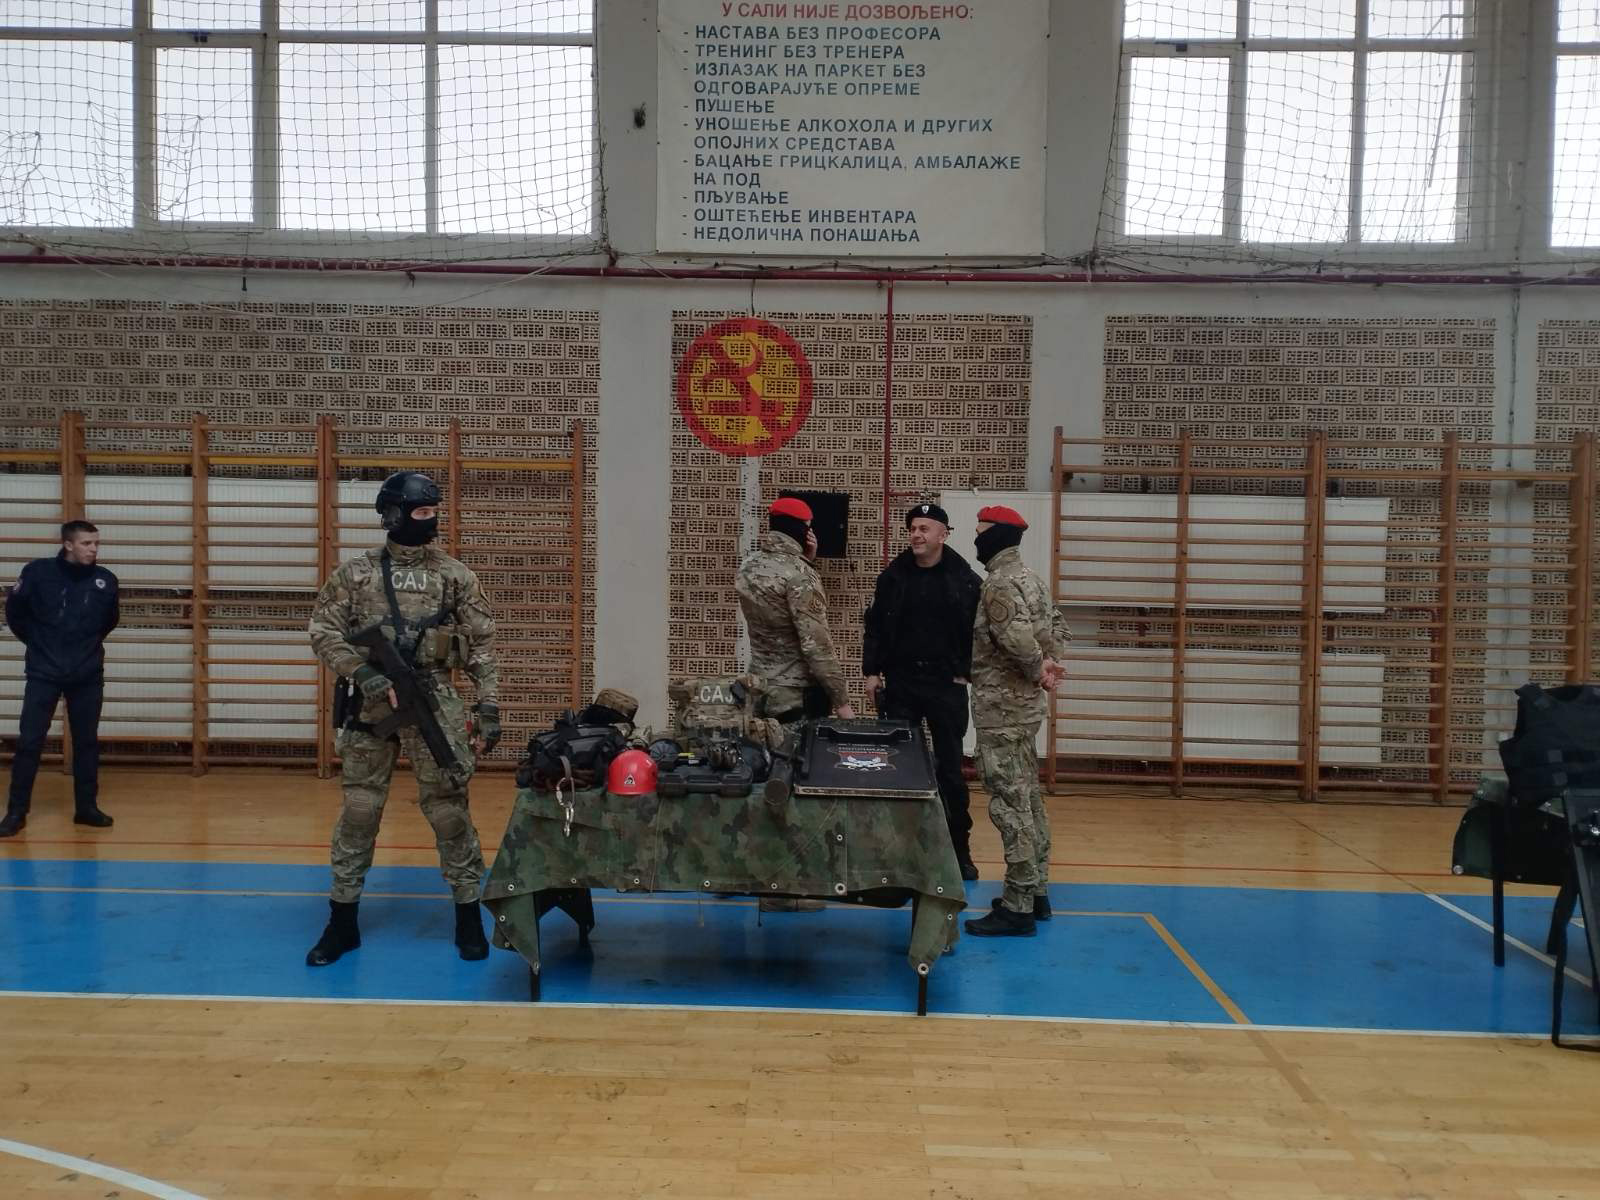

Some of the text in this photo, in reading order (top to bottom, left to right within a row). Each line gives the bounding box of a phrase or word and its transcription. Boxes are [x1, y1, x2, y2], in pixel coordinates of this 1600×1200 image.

[722, 2, 973, 21] У САЛИ НИЈЕ ДОЗВОЉЕНО:
[696, 25, 779, 40] НАСТАВА
[787, 27, 819, 40] БЕЗ
[827, 27, 940, 40] ПРОФЕСОРА
[695, 44, 777, 58] ТРЕНИНГ
[784, 45, 816, 58] БЕЗ
[823, 45, 904, 59] ТРЕНЕРА
[696, 62, 778, 77] ИЗЛАЗАК
[786, 64, 807, 77] НА
[816, 64, 886, 77] ПАРКЕТ
[893, 64, 925, 77] БЕЗ
[694, 80, 920, 96] ОДГОВАРАЈУЋЕ ОПРЕМЕ
[696, 98, 774, 113] ПУШЕЊЕ
[695, 117, 790, 132] УНОШЕЊЕ
[797, 119, 897, 132] АЛКОХОЛА
[905, 119, 914, 132] И
[922, 119, 992, 135] ДРУГИХ
[694, 136, 895, 152] ОПОЈНИХ СРЕДСТАВА
[695, 154, 772, 170] БАЦАЊЕ
[914, 155, 1020, 169] АМБАЛАЖЕ
[694, 172, 760, 189] НА ПОД
[695, 191, 789, 204] ПЉУВАЊЕ
[694, 208, 801, 223] ОШТЕЋЕЊЕ
[809, 210, 916, 223] ИНВЕНТАРА
[694, 226, 803, 242] НЕДОЛИЧНА
[811, 228, 920, 242] ПОНАШАЊА
[391, 571, 426, 590] САЈ
